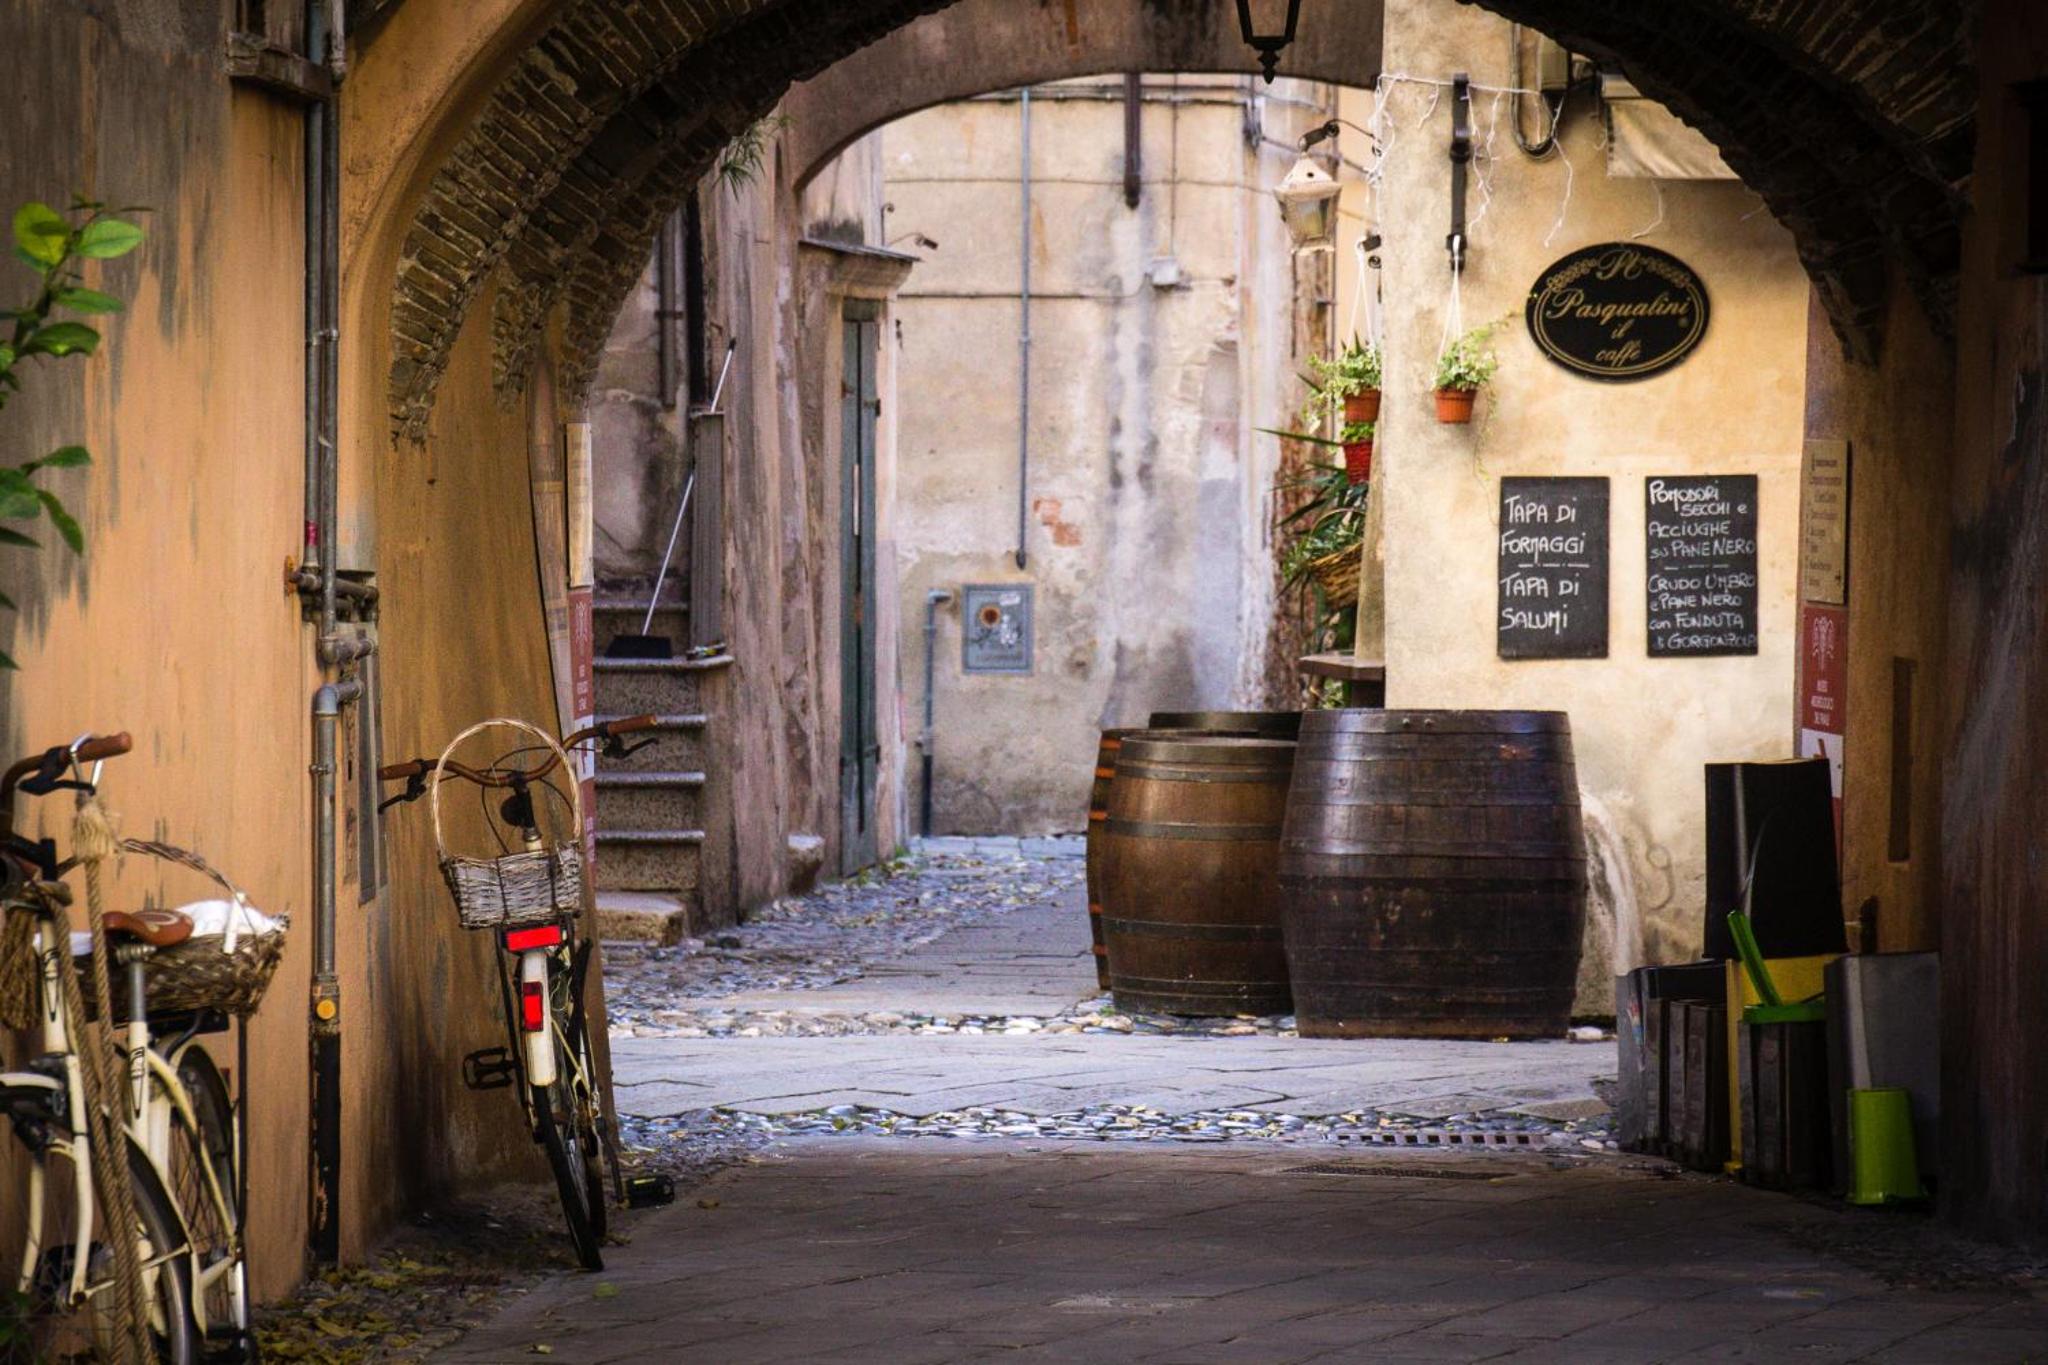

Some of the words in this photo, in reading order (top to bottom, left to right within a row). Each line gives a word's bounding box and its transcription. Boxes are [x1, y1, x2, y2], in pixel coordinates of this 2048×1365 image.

[1546, 288, 1692, 326] Pasqualini
[1611, 319, 1635, 340] il
[1504, 495, 1548, 523] TAPA
[1680, 502, 1730, 517] SECCHI
[1671, 539, 1711, 557] PANE
[1713, 538, 1756, 555] NERO
[1500, 572, 1549, 598] TAPA
[1648, 574, 1701, 593] CRUDO
[1705, 572, 1756, 593] UMBRO
[1659, 593, 1697, 609] PANE
[1701, 592, 1742, 606] NERO
[1674, 612, 1744, 629] FONDUTA
